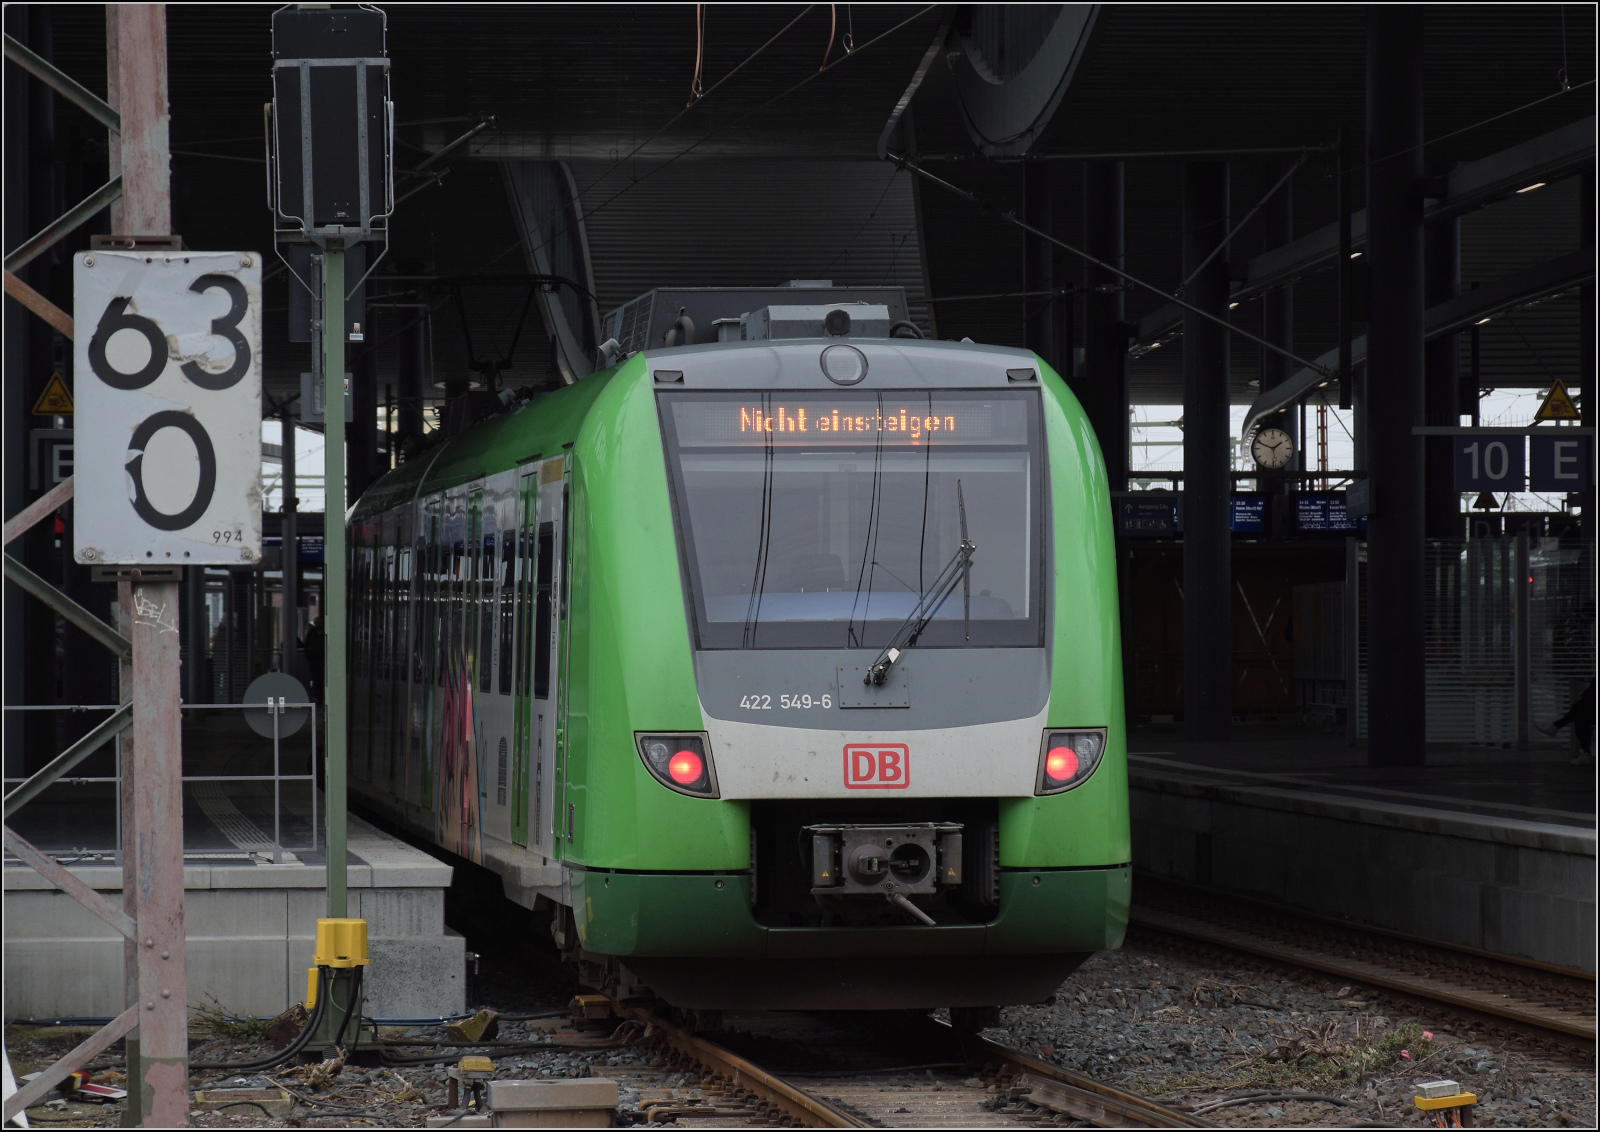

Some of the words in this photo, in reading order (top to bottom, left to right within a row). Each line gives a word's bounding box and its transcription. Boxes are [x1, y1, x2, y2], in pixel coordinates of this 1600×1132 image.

[88, 272, 252, 391] 63
[741, 407, 807, 432] Nicht
[816, 408, 955, 438] einsteigen
[124, 410, 217, 532] 0
[1463, 441, 1509, 480] 10
[1554, 441, 1579, 479] E
[213, 530, 242, 543] 994
[740, 694, 772, 709] 422
[780, 694, 832, 709] 549-6
[850, 749, 904, 783] DB
